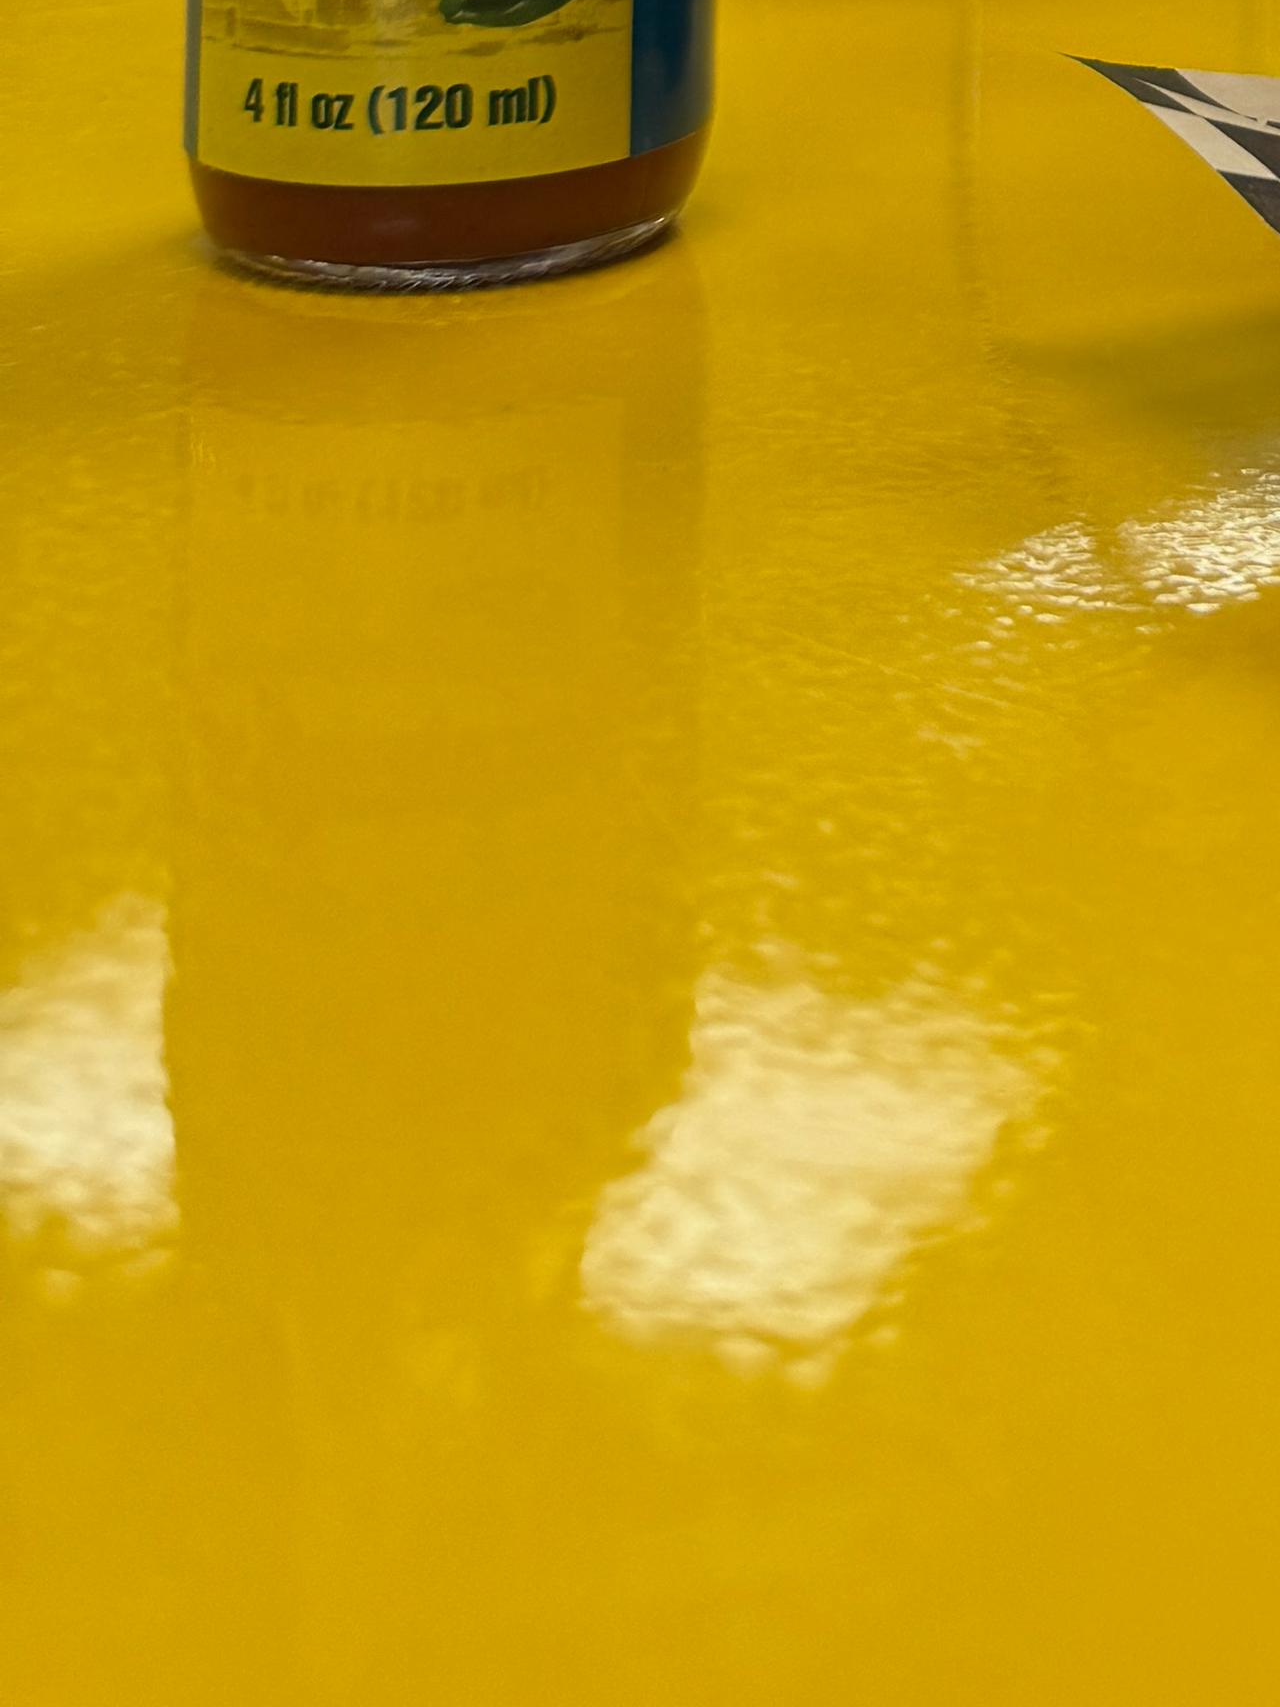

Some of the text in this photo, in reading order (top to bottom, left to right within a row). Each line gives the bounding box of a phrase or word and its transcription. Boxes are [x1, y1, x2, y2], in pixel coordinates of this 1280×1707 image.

[243, 74, 558, 136] 4 fl oz (120 ml)
